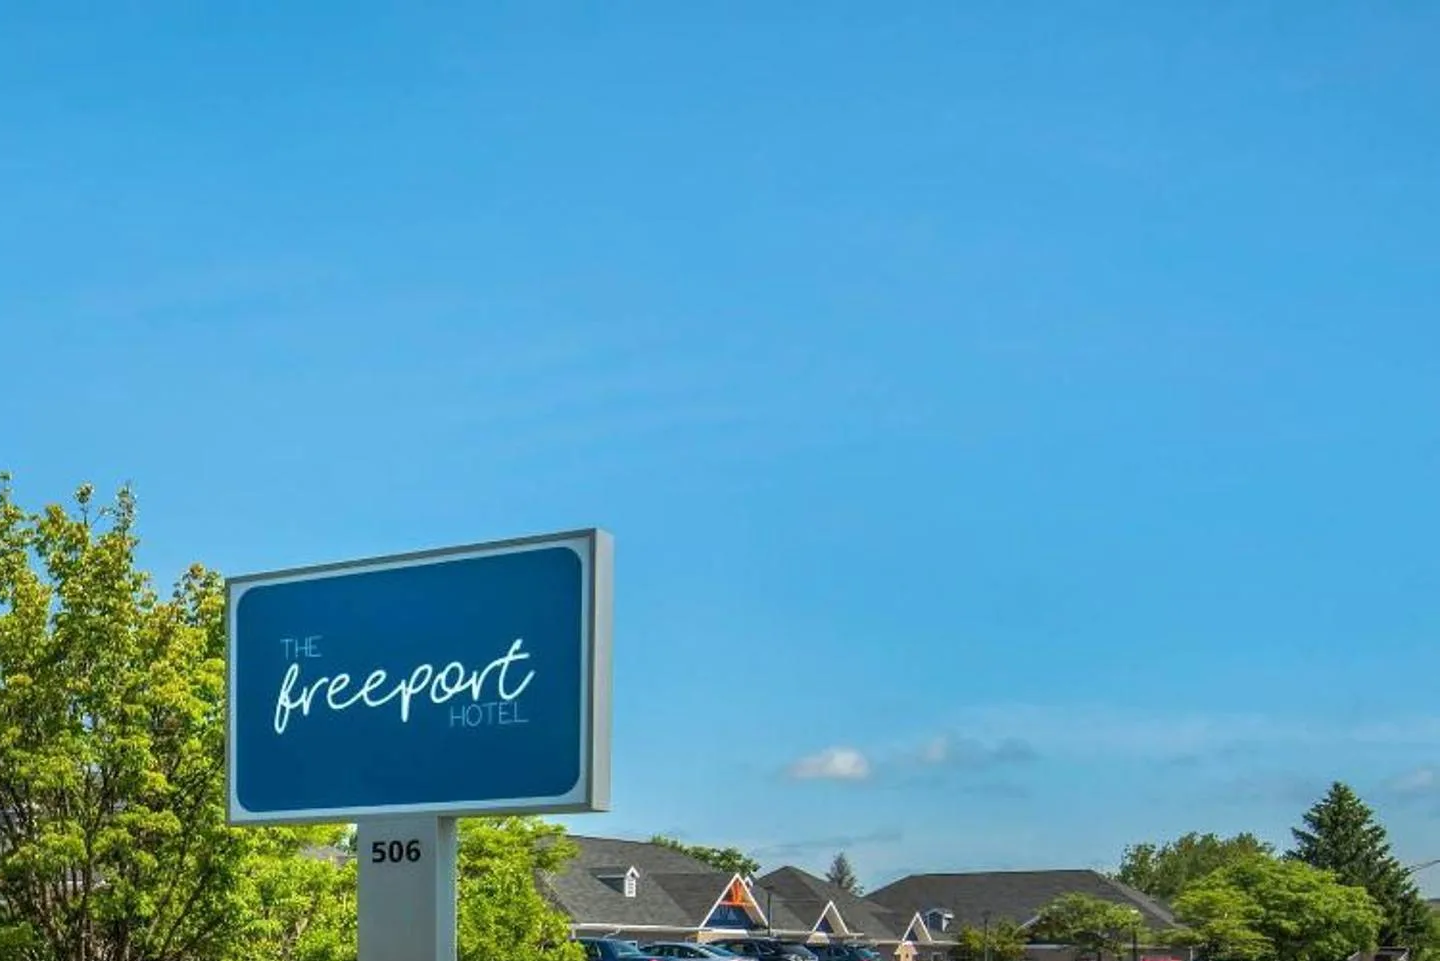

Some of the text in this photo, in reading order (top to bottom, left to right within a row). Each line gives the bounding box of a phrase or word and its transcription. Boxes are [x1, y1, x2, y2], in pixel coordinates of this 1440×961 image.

[280, 636, 322, 659] THE
[274, 638, 536, 734] freeport
[449, 701, 529, 728] HOTEL
[371, 839, 421, 863] 506
